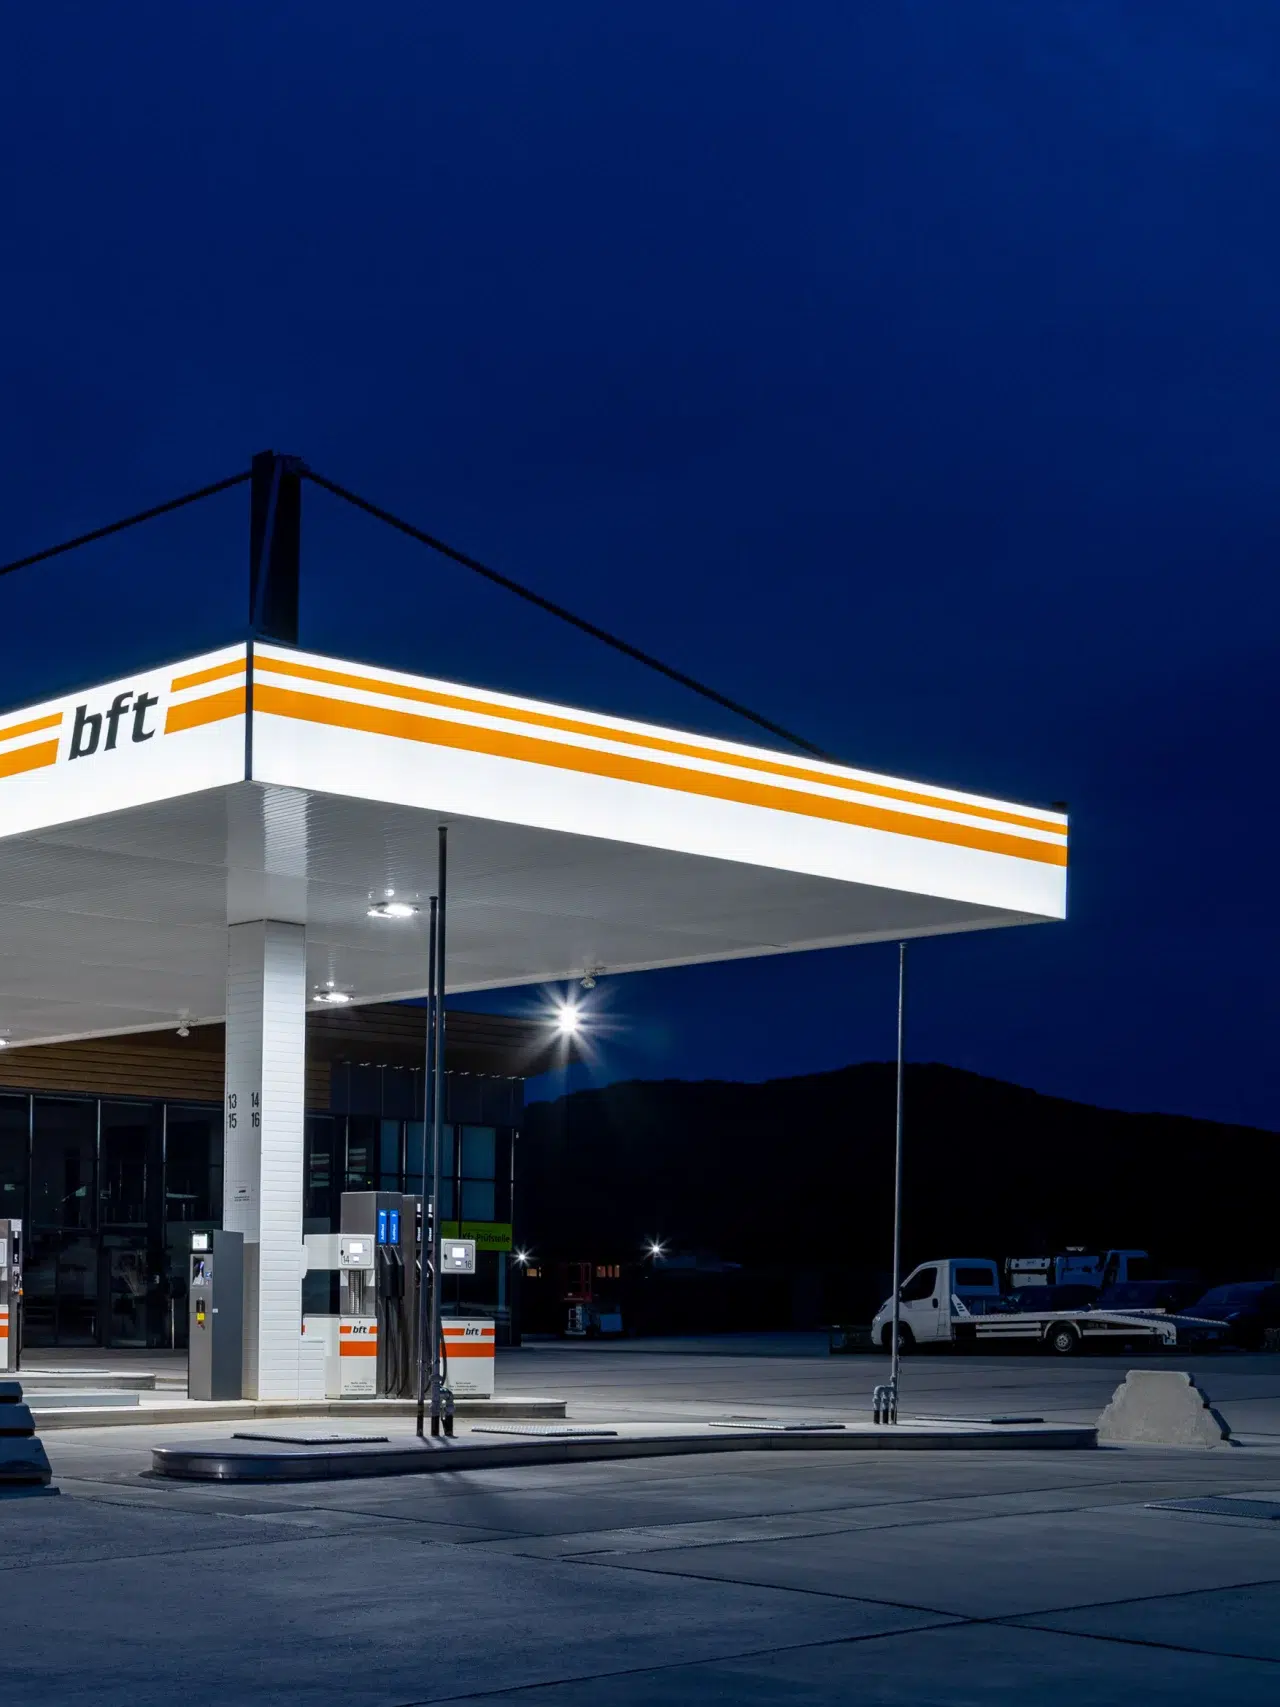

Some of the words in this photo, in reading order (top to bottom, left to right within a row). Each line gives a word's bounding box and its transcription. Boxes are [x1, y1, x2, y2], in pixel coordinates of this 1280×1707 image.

[68, 691, 159, 761] bft
[228, 1093, 237, 1109] 13
[251, 1091, 260, 1108] 14
[228, 1113, 237, 1129] 15
[251, 1111, 260, 1128] 16
[462, 1231, 510, 1243] Kfz-Prüfstelle
[343, 1255, 350, 1264] 14
[465, 1260, 472, 1269] 16
[352, 1325, 368, 1334] bft
[465, 1327, 480, 1336] bft
